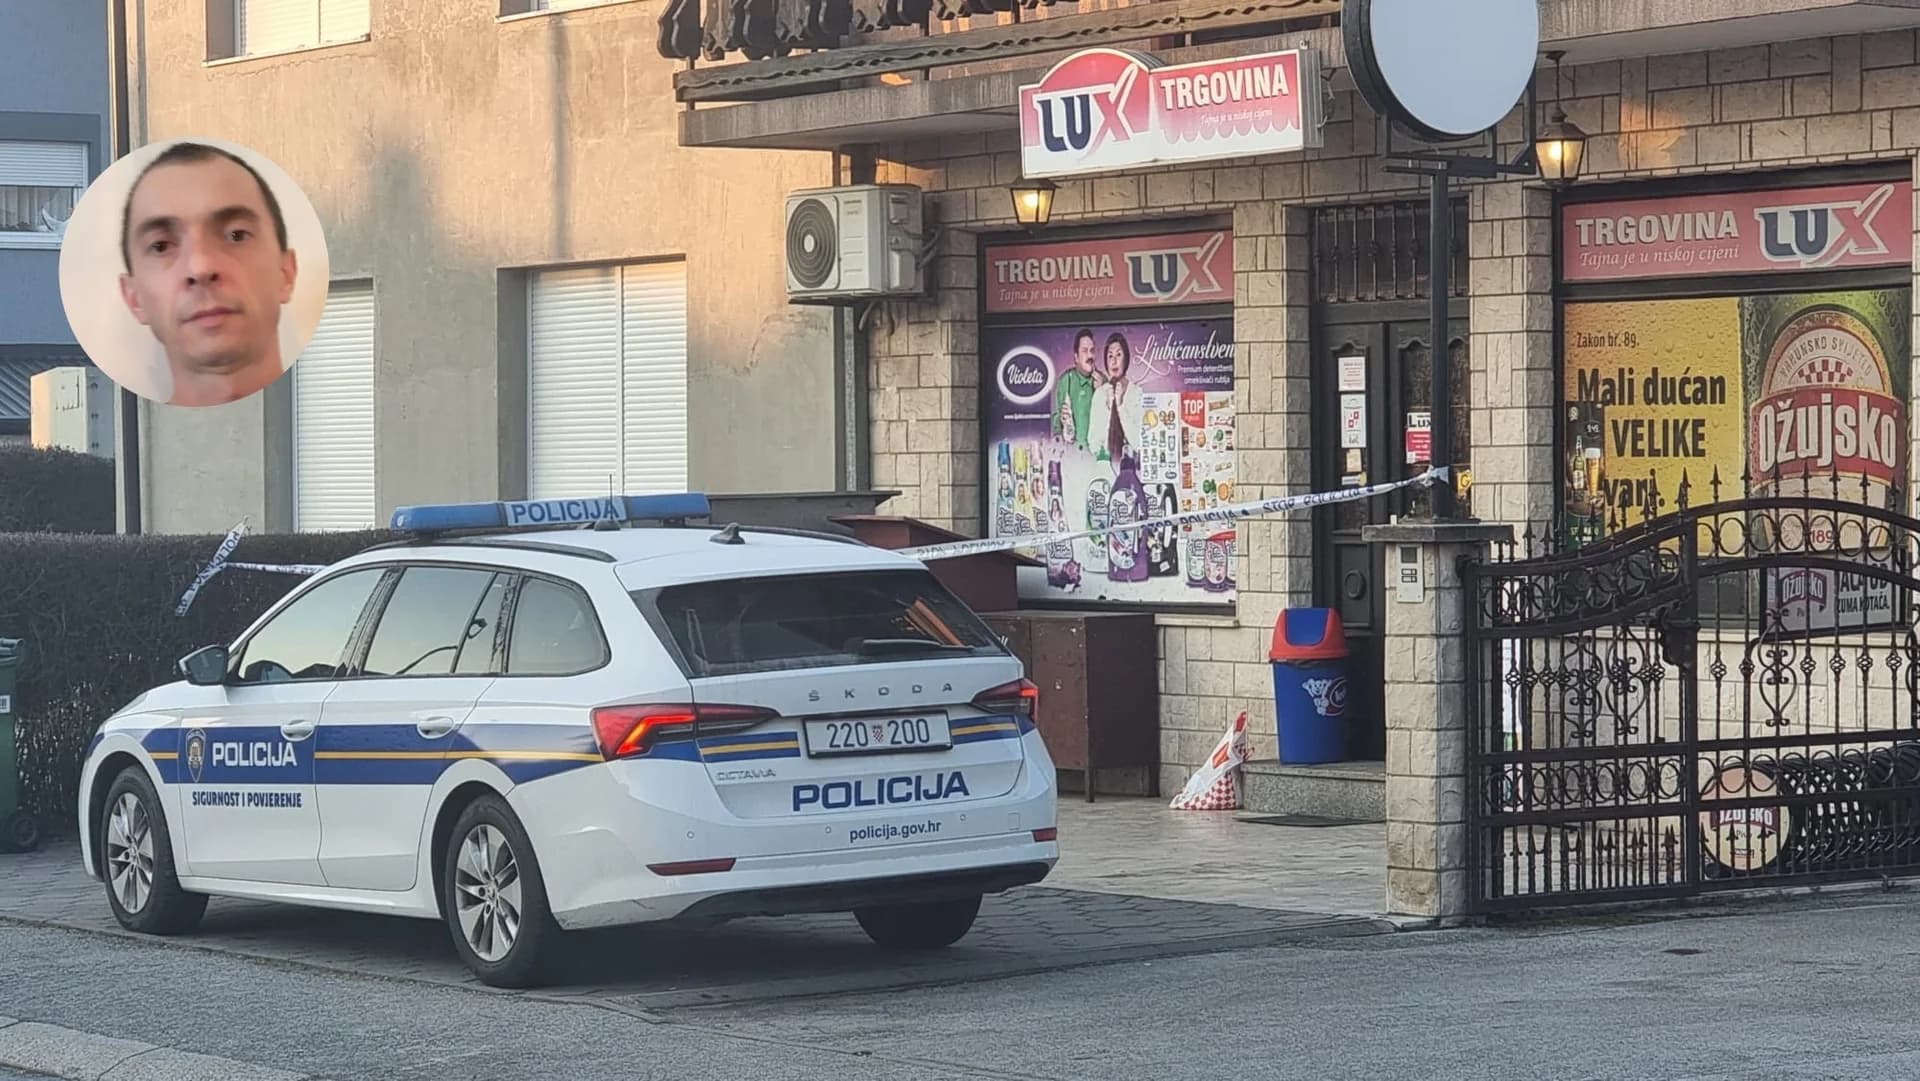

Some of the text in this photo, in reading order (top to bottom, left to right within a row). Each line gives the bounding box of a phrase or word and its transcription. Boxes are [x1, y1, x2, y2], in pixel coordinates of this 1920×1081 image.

[1160, 64, 1289, 110] TRGOVINA
[1036, 64, 1138, 160] LUX
[1576, 210, 1740, 247] TRGOVINA
[1754, 184, 1895, 266] LUX
[995, 253, 1115, 285] TRGOVINA
[1125, 232, 1224, 302] LUX
[1580, 245, 1740, 269] Tajna je u niskoj cijeni
[999, 285, 1115, 304] Tajna je u niskoj cijeni
[1577, 331, 1640, 347] Zakon br. 89.
[1007, 364, 1044, 386] Violeta
[1578, 366, 1726, 405] Mali dućan
[1184, 400, 1204, 415] TOP
[1611, 419, 1706, 457] VELIKE
[1760, 394, 1897, 473] Ožujsko
[513, 502, 619, 524] POLICIJA
[808, 682, 953, 702] ŠKODA
[826, 718, 930, 748] 220 200
[212, 742, 297, 767] POLICIJA
[192, 792, 302, 808] SIGURNOST I POVJERENJE
[792, 771, 970, 812] POLICIJA
[849, 820, 942, 842] policija.gov.hr
